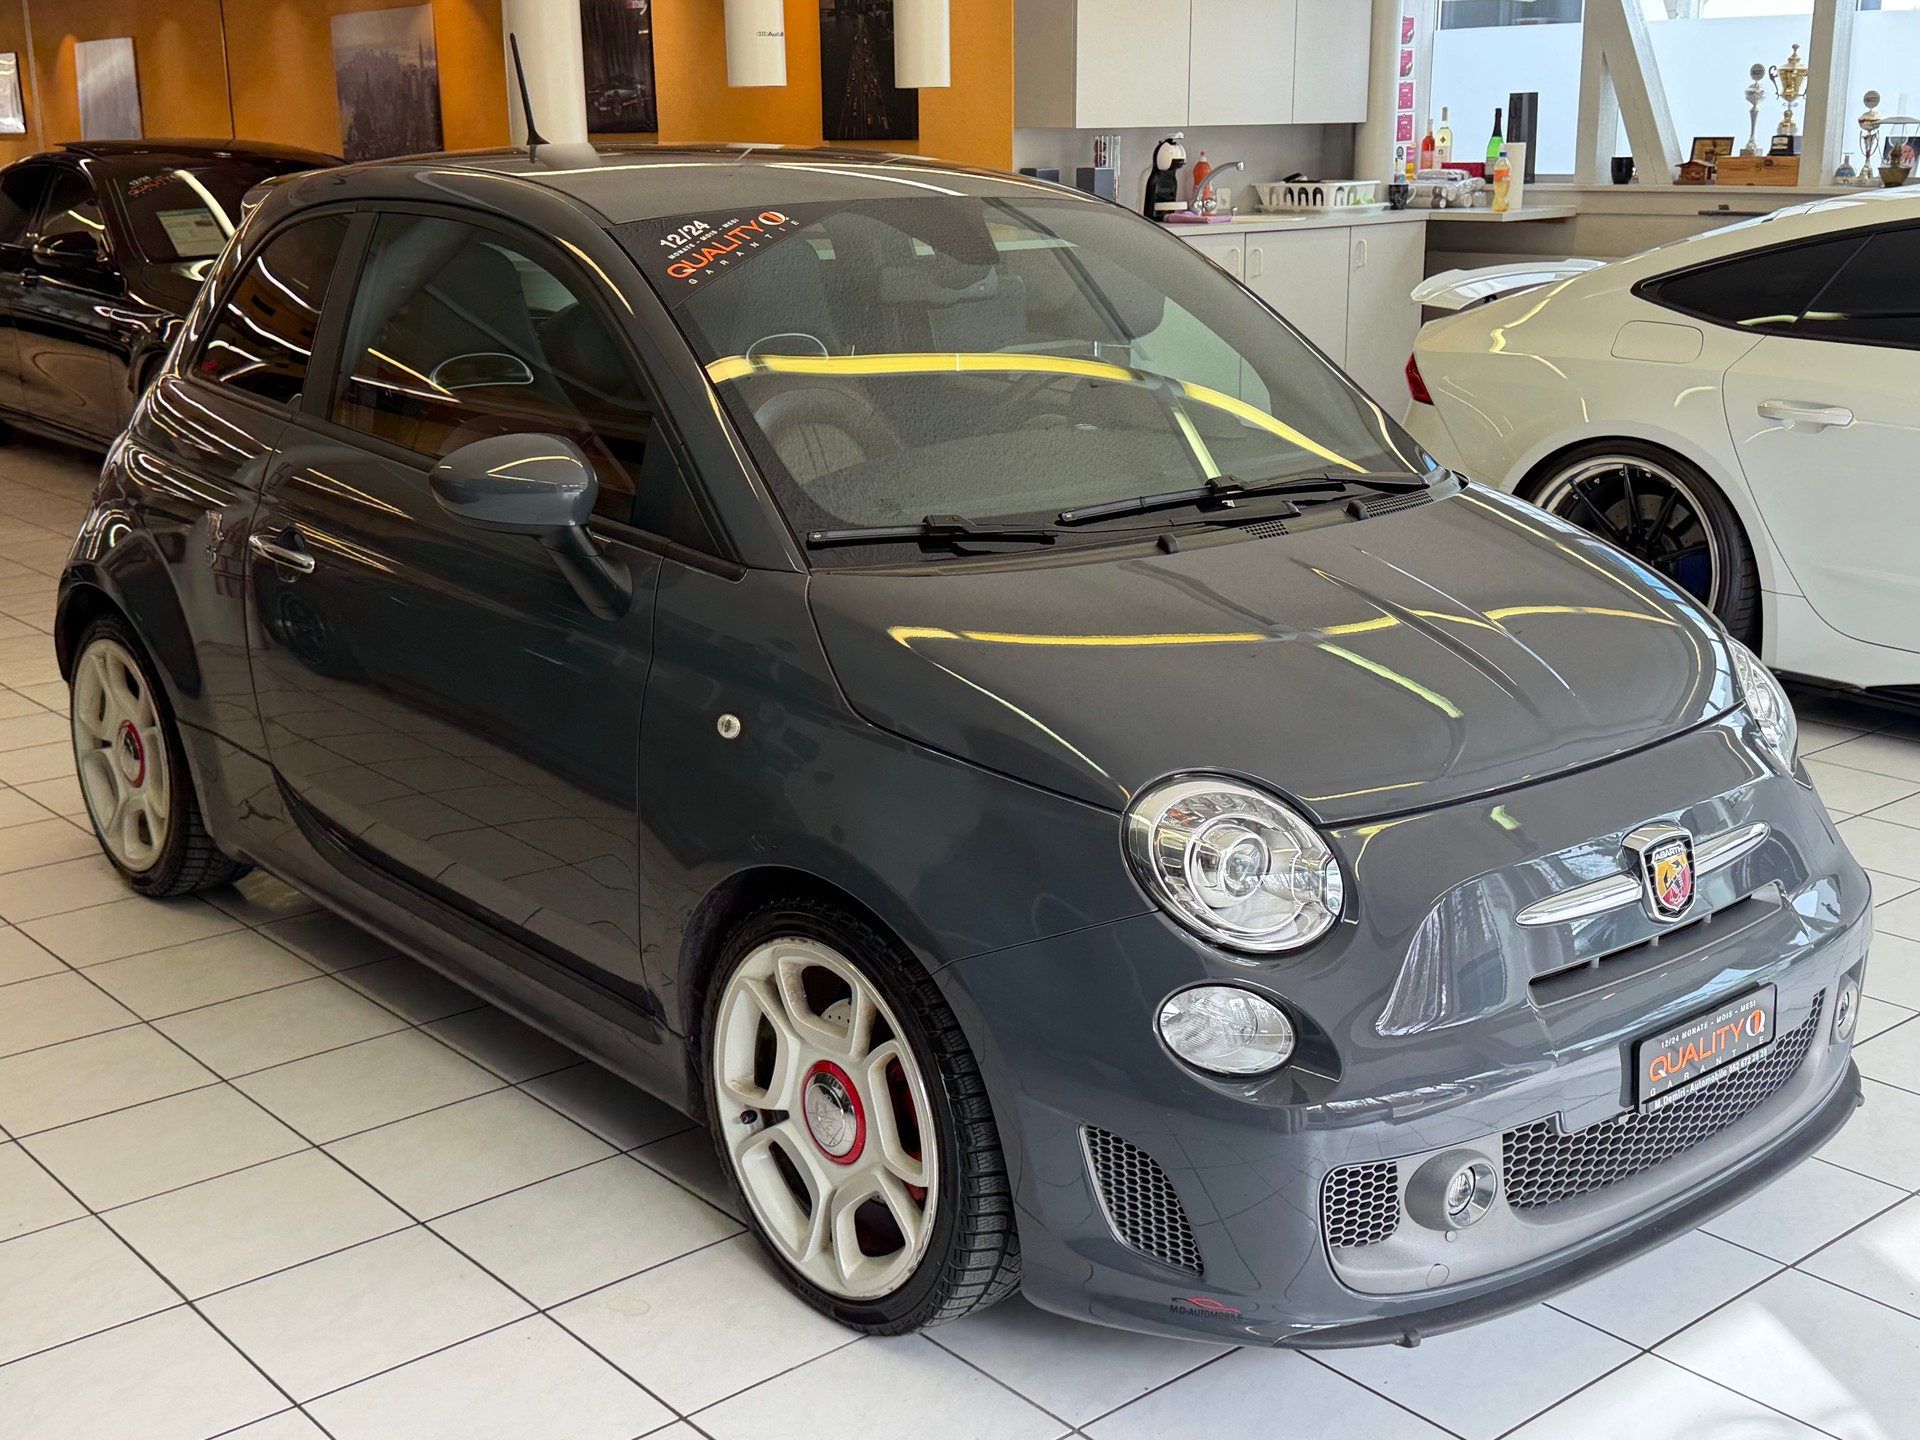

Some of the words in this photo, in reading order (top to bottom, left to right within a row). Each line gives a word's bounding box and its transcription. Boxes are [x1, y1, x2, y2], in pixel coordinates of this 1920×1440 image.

[660, 219, 711, 249] 12/24
[667, 243, 696, 260] MONATE
[700, 229, 718, 241] MOIS
[722, 218, 740, 228] MESI
[667, 219, 765, 279] QUALITY
[688, 219, 800, 285] GARANTIE
[1655, 845, 1683, 861] ABARTH
[1650, 1018, 1745, 1082] QUALITY
[1661, 1034, 1679, 1048] 12/24
[1681, 1021, 1708, 1039] MONATE
[1716, 1011, 1733, 1024] MOIS
[1740, 1000, 1756, 1013] MESI
[1650, 1036, 1764, 1097] GARANTIE
